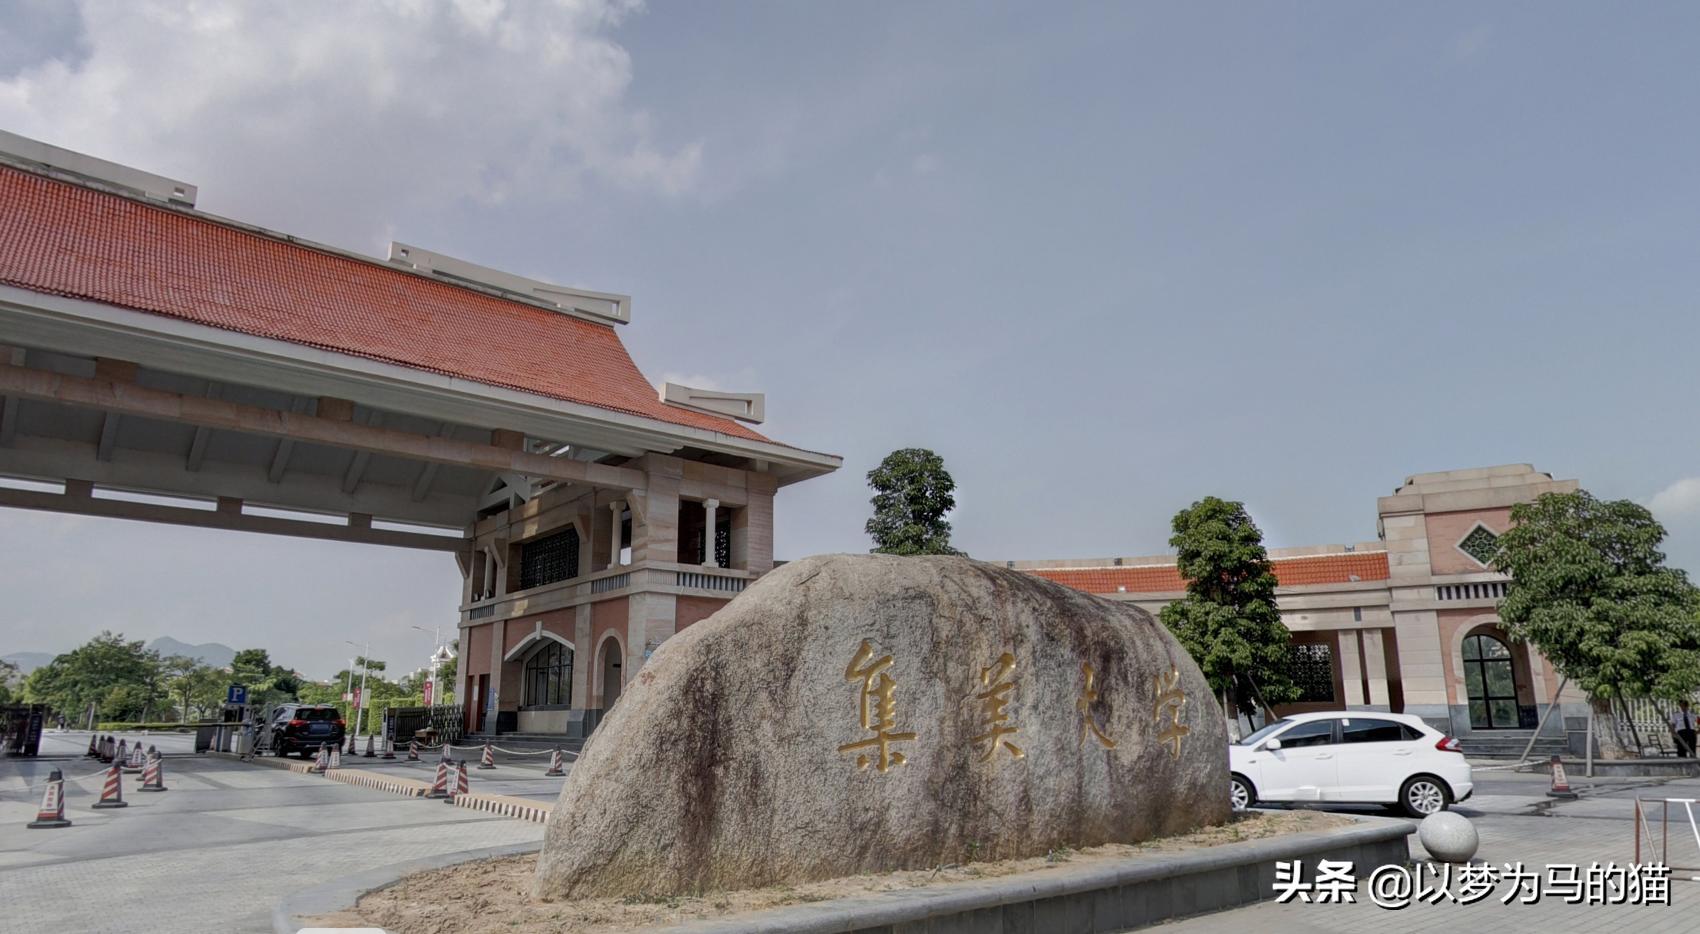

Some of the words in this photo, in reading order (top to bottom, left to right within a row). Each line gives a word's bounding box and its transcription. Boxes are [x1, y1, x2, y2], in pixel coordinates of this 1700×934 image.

[231, 687, 244, 702] P
[838, 638, 1190, 772] 集美大学
